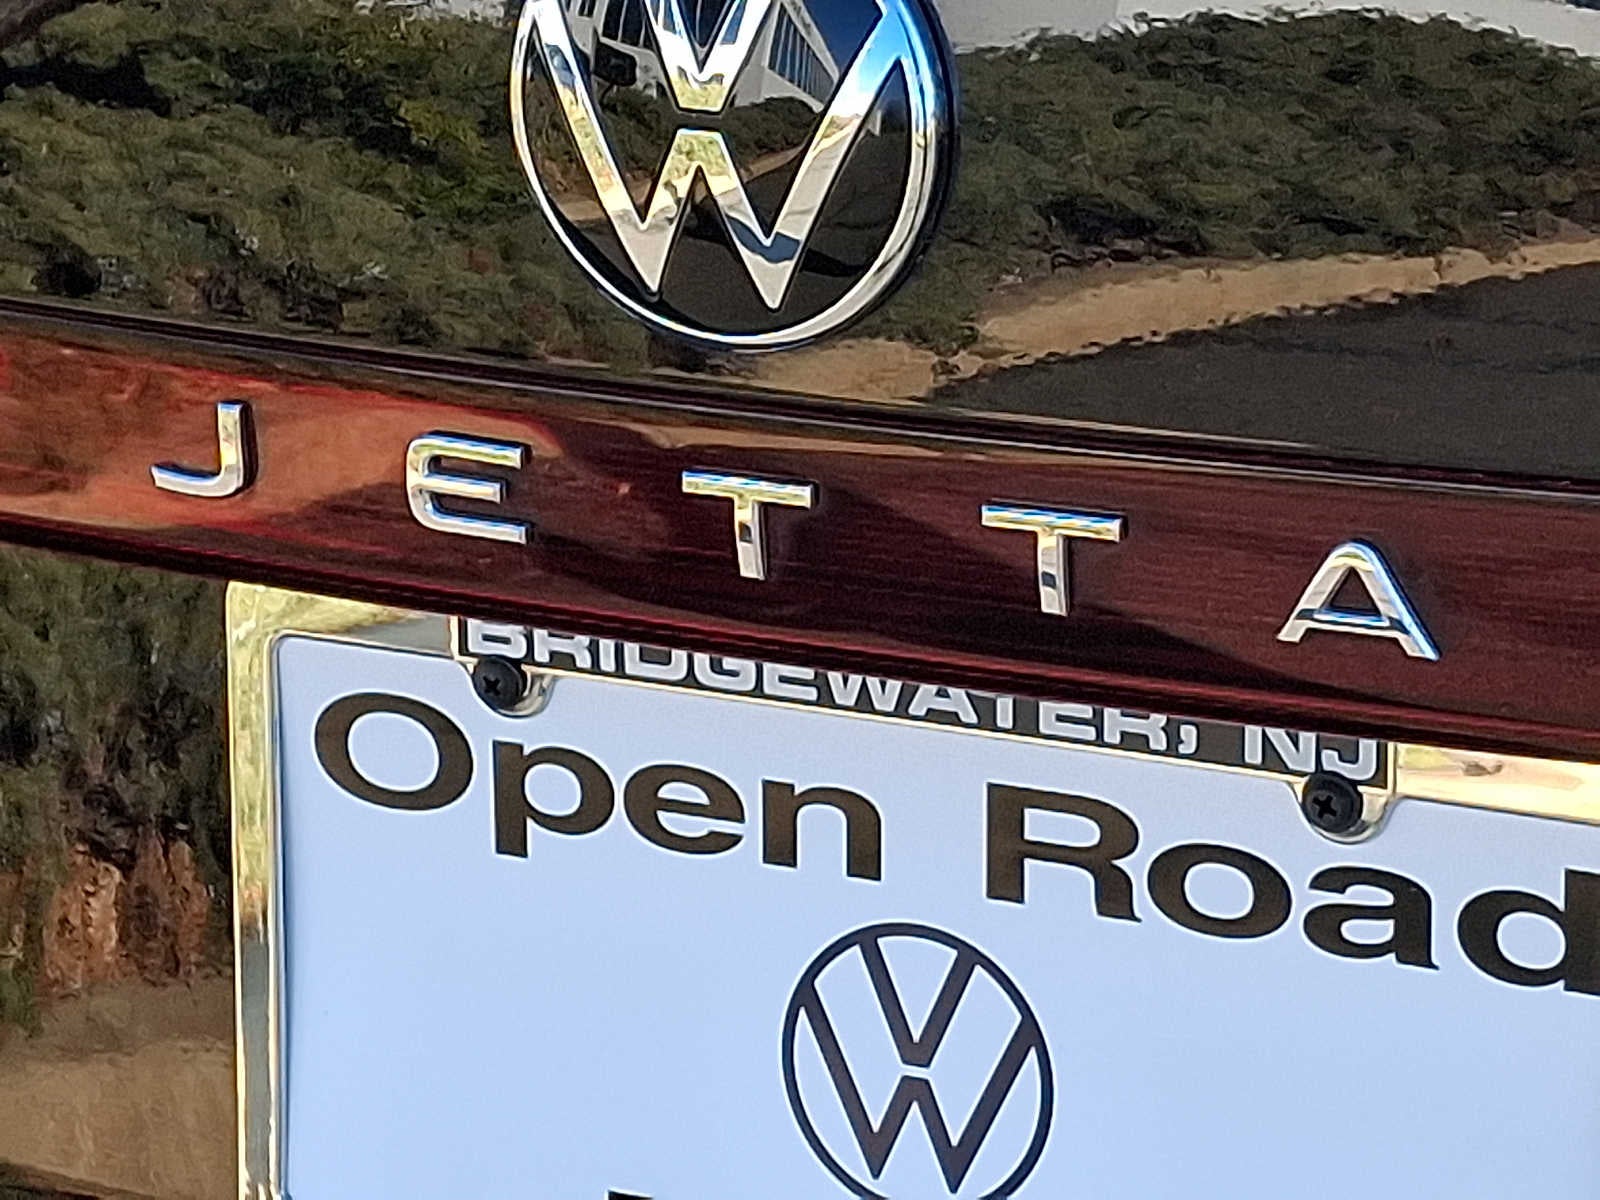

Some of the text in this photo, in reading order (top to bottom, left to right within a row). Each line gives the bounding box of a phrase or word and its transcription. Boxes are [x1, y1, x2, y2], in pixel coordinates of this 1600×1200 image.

[152, 402, 1441, 661] JETTA
[467, 618, 1377, 780] BRIDGEWATER, NJ
[314, 692, 1600, 995] Open Road
